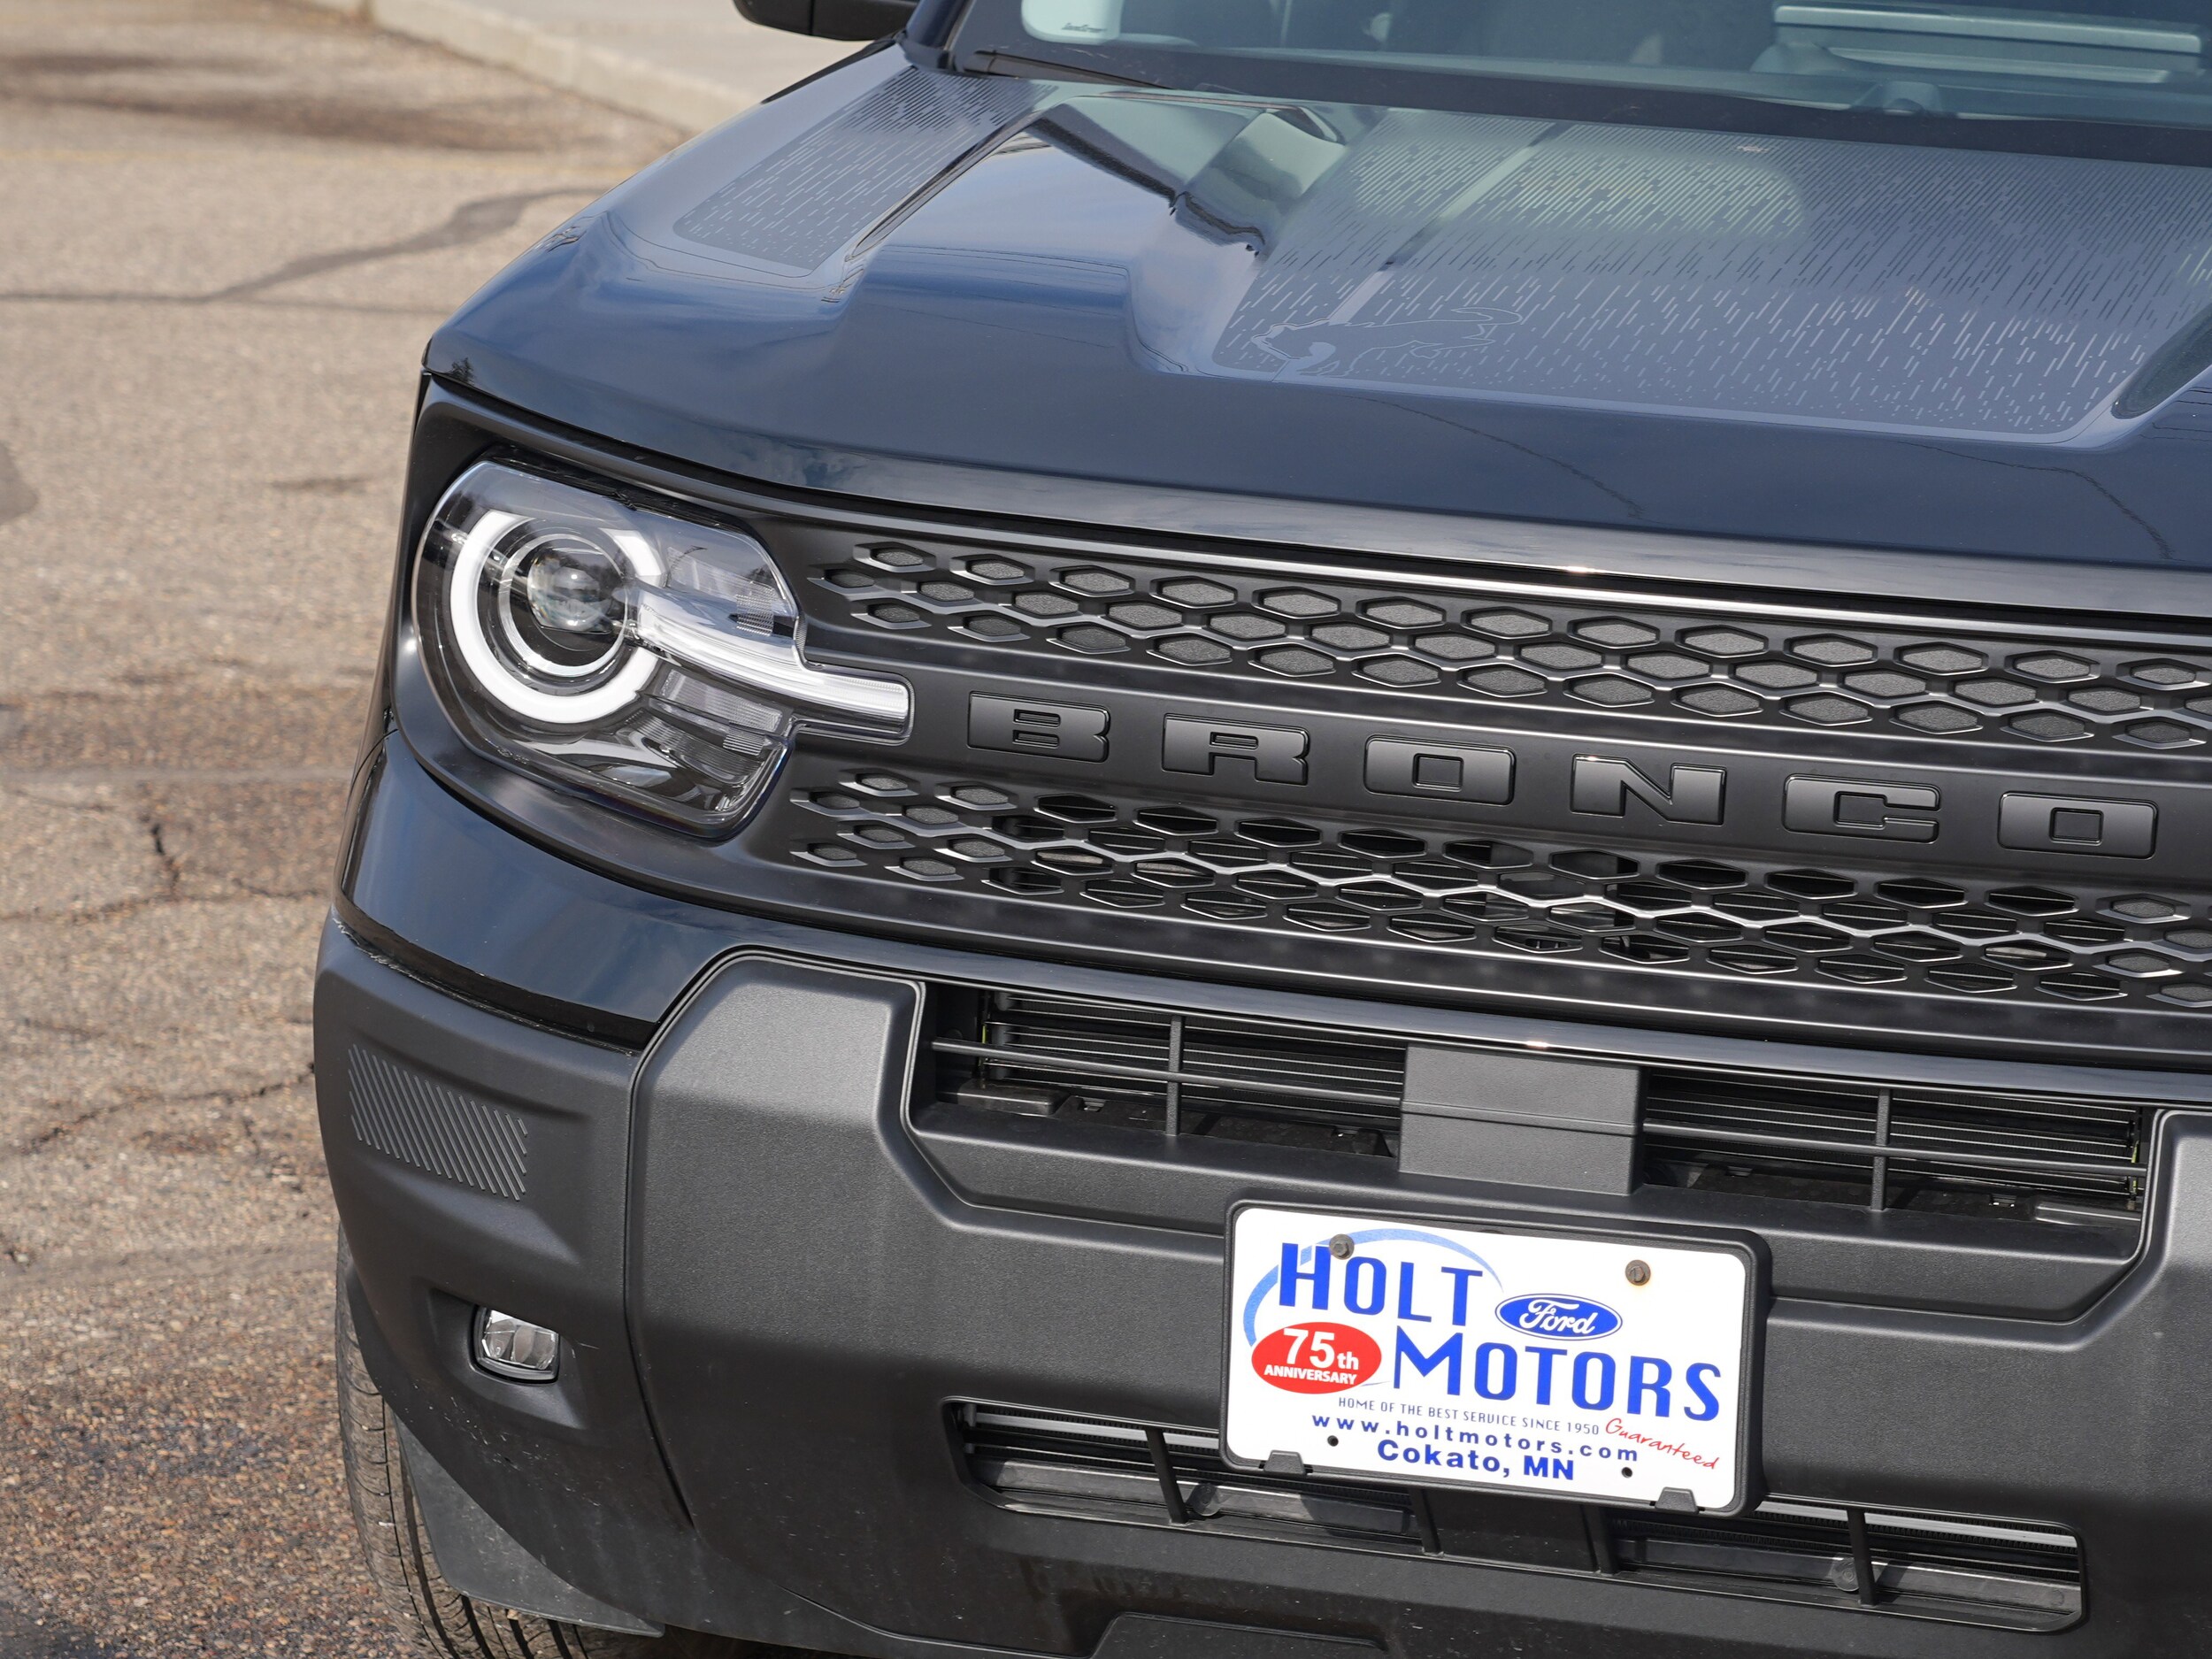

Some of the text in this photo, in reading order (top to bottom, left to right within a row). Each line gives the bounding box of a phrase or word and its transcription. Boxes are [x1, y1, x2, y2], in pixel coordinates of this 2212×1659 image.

[968, 690, 2158, 859] BRONCO
[1279, 1242, 1483, 1326] HOLT
[1519, 1299, 1598, 1334] Ford
[1283, 1327, 1359, 1371] 75th
[1263, 1364, 1357, 1386] ANNIVERSARY
[1394, 1325, 1721, 1422] MOTORS
[1339, 1396, 1600, 1435] HOME OF THE BEST SERVICE SINCE 1950
[1311, 1415, 1638, 1462] www.holtmotors.com
[1377, 1439, 1574, 1480] Cokato, MN
[1605, 1417, 1720, 1470] Guaranteed
